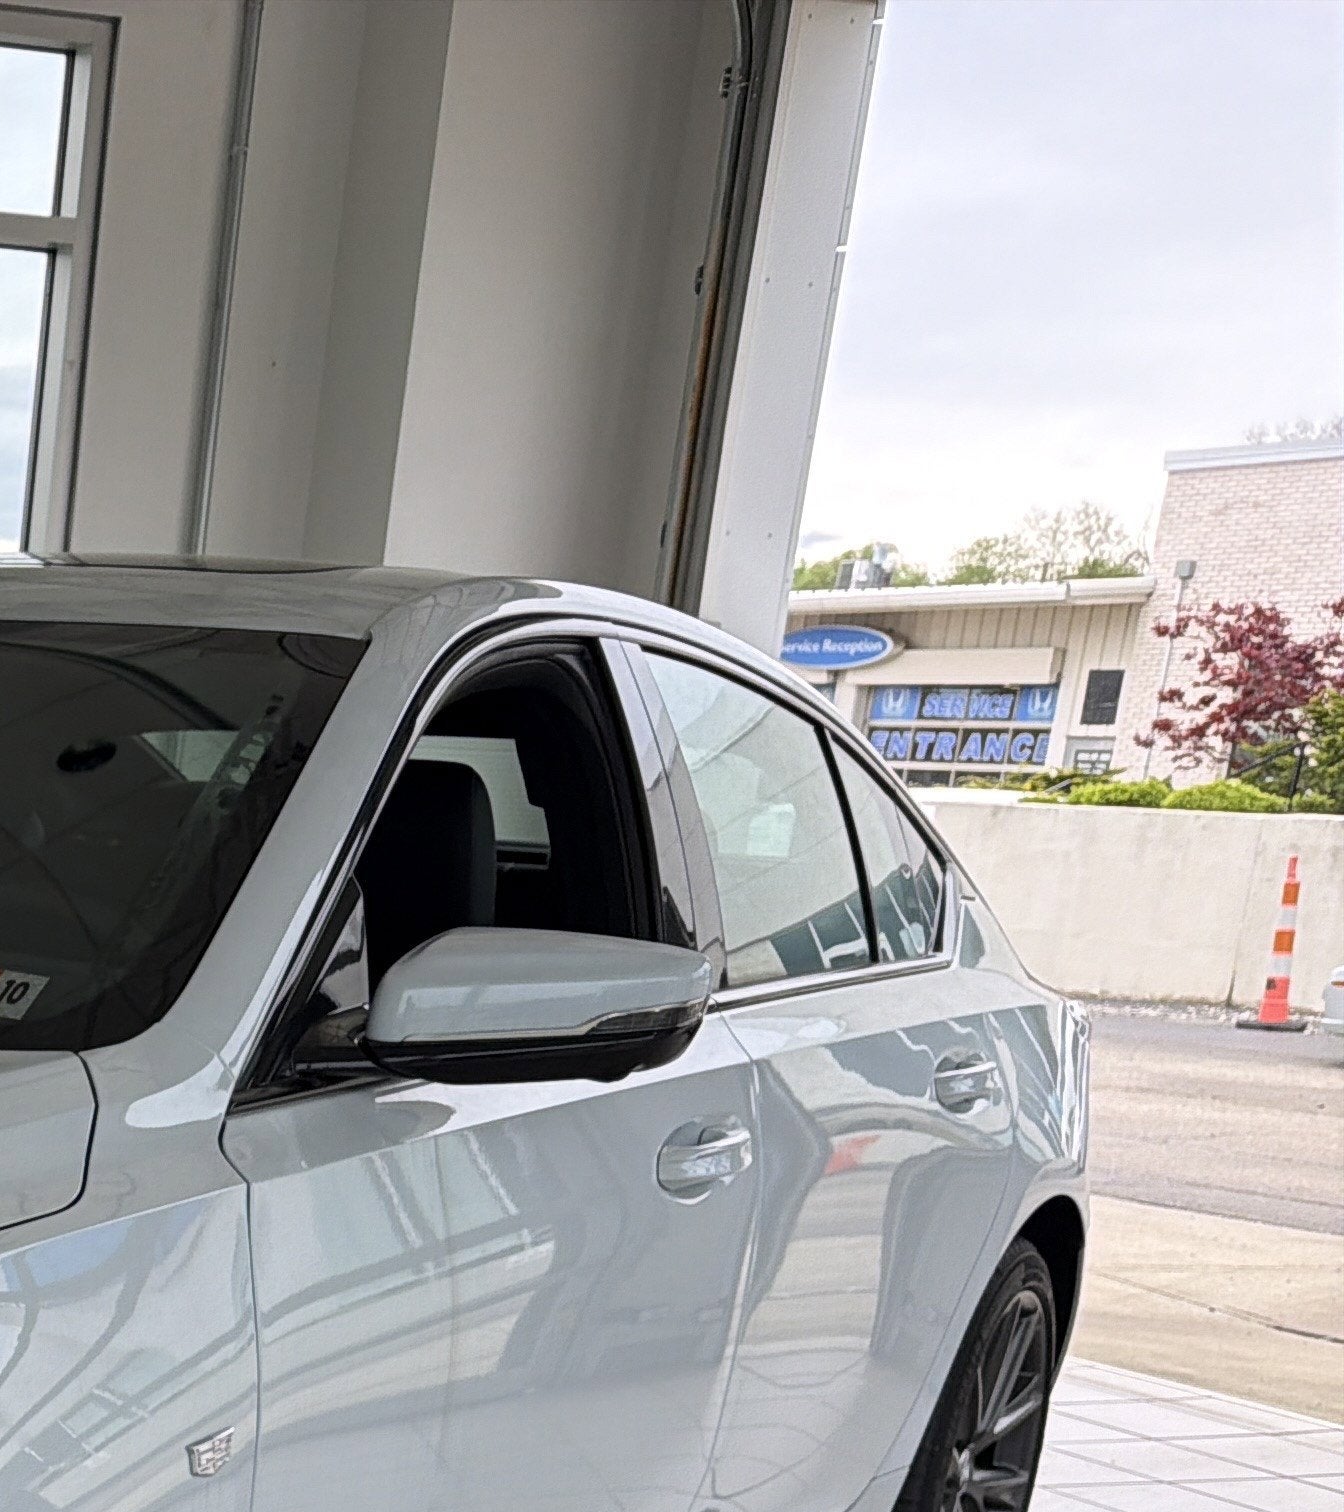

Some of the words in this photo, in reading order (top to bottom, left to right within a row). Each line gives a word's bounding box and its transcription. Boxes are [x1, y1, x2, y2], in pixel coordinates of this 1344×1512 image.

[782, 638, 820, 654] ervice
[822, 637, 884, 656] Reception
[923, 693, 1015, 719] SERVICE
